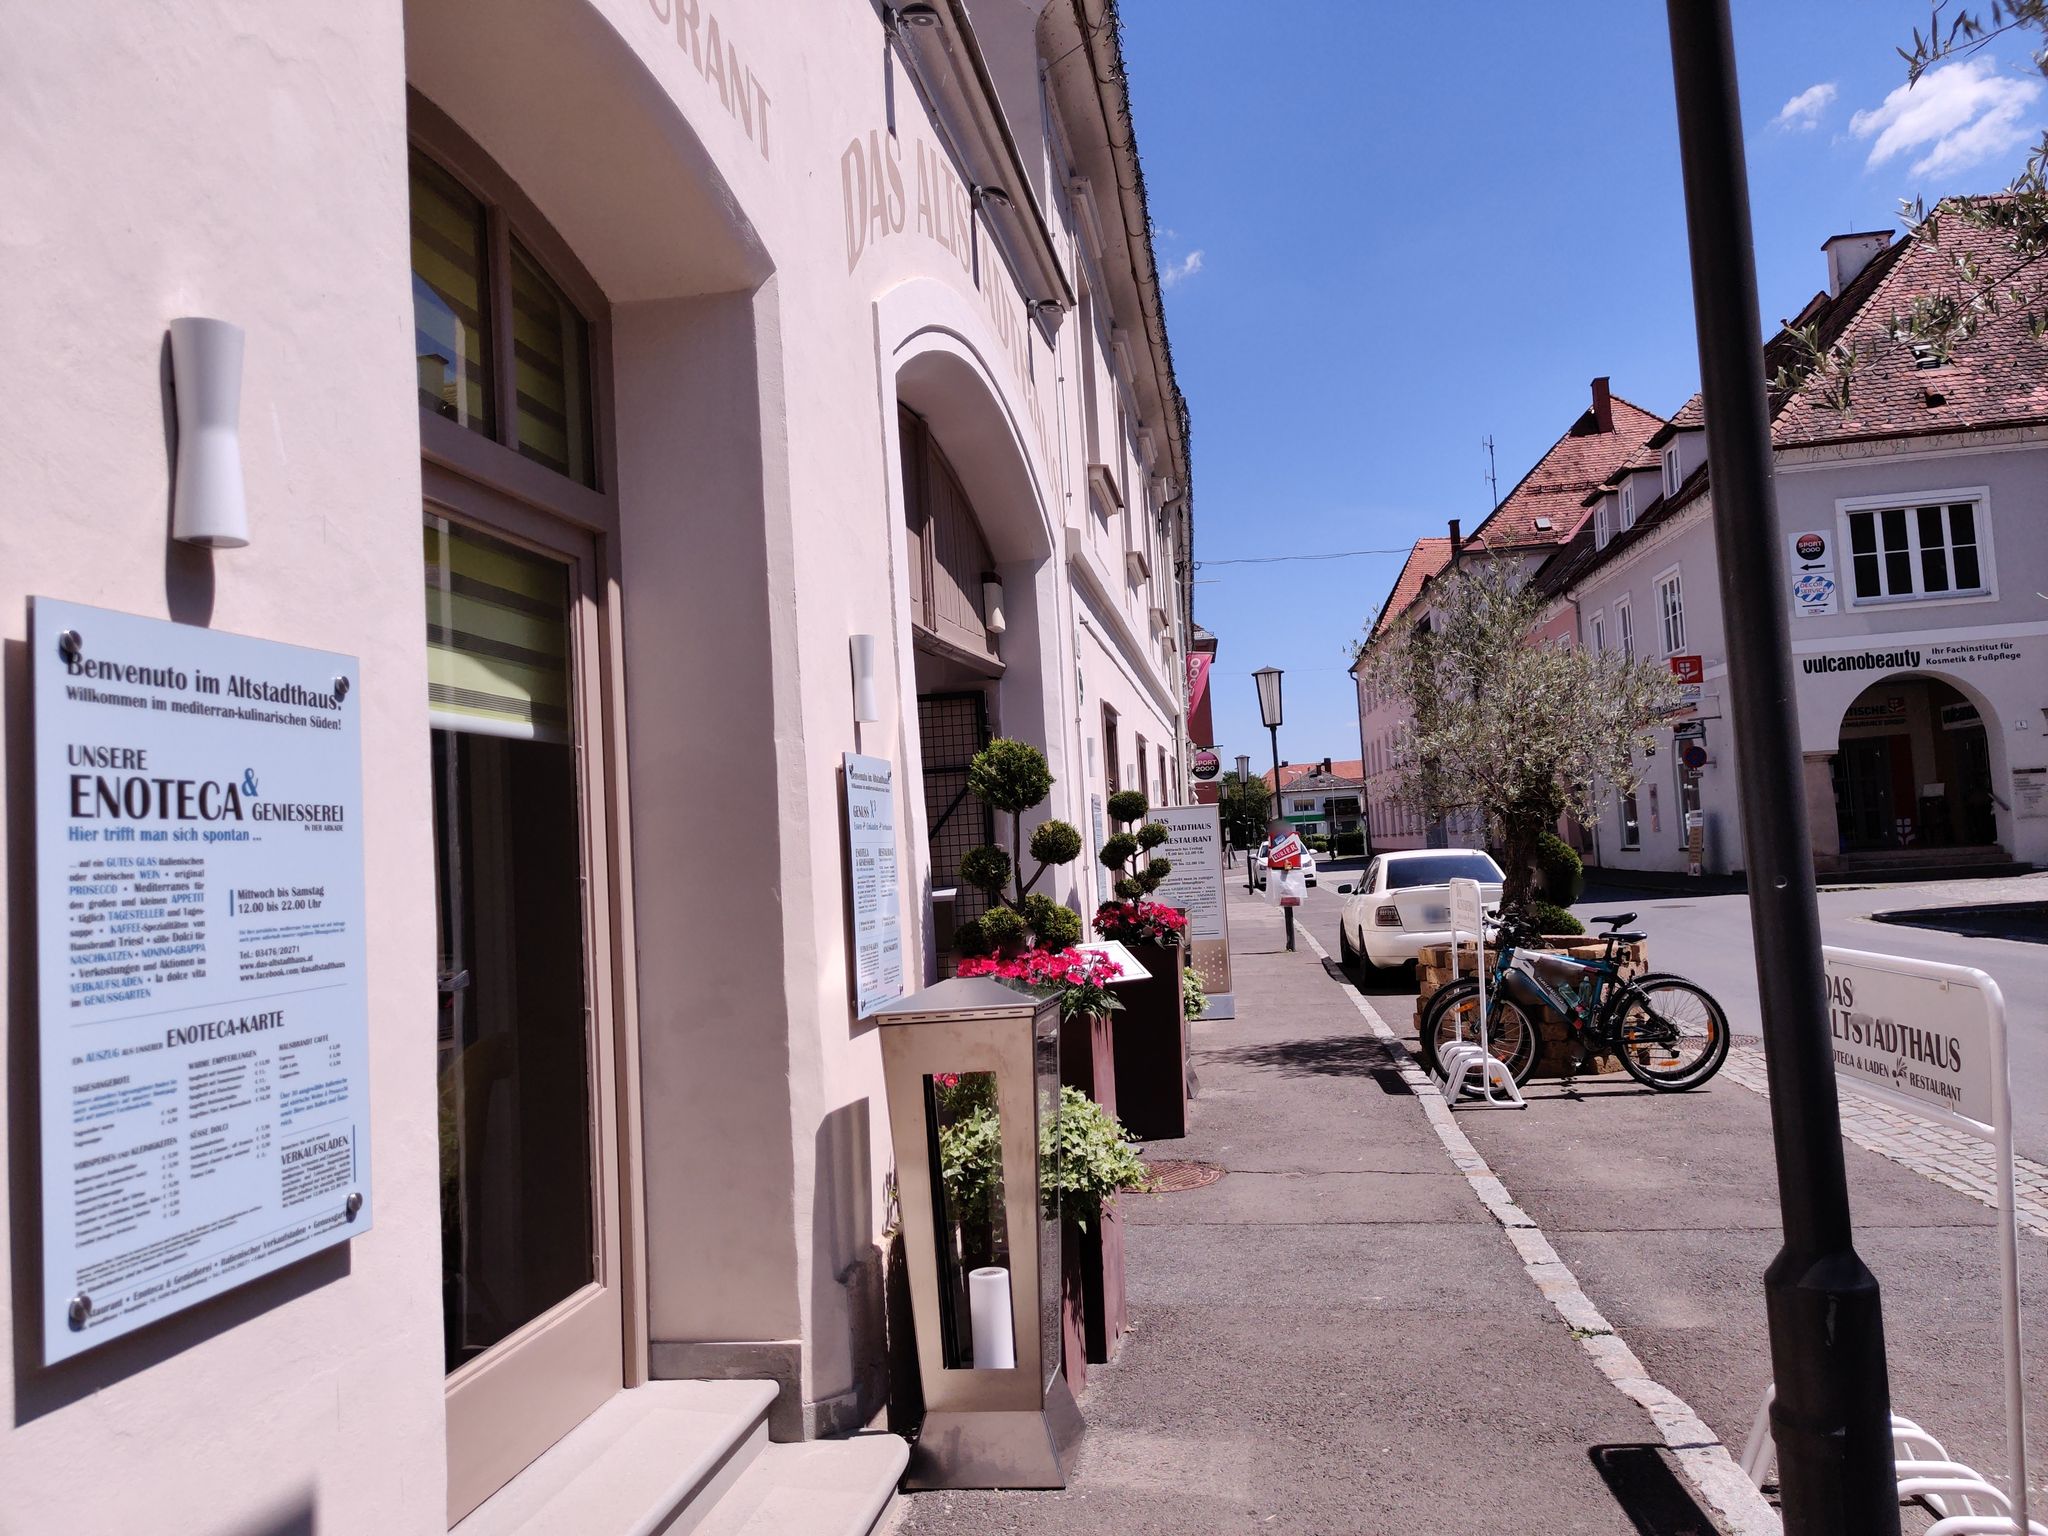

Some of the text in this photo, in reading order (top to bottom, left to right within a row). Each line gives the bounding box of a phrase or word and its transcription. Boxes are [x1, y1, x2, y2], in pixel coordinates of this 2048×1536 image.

[841, 128, 905, 276] DAS
[1798, 540, 1823, 549] SPORT
[1931, 641, 2014, 655] Ihr Fachinstitut für
[1802, 649, 1921, 674] vulcanobeauty
[1926, 652, 2022, 665] Kosmetik & Fußpflege
[67, 651, 188, 690] Benvenuto
[195, 669, 220, 694] im
[66, 686, 342, 730] Willkommen im mediterran-kulinarischen Süden!
[67, 744, 149, 771] UNSERE
[1195, 759, 1217, 767] SPORT
[70, 767, 259, 821] ENOTECA &
[252, 802, 344, 822] GENIESSEREI
[68, 826, 98, 842] Hier
[103, 826, 137, 842] trifft
[140, 829, 169, 842] man
[172, 826, 199, 842] sich
[203, 829, 250, 844] spontan
[106, 857, 134, 867] GUTES
[136, 857, 158, 867] GLAS
[140, 870, 161, 879] WEIN
[174, 869, 205, 879] original
[69, 884, 118, 896] PROSECCO
[134, 882, 190, 893] Mediterranes
[238, 885, 325, 900] Mittwoch bis Samstag
[121, 897, 136, 906] und
[171, 893, 205, 903] APPETIT
[238, 898, 323, 914] 12.00 bis 22.00 Uhr
[108, 908, 166, 921] TAGESTELLER
[118, 936, 145, 947] Triest
[172, 931, 194, 942] Dolci
[70, 950, 134, 965] NASCHKATZEN
[79, 964, 141, 978] Verkostungen
[160, 958, 195, 969] Aktionen
[70, 976, 144, 993] VERKAUFSLADEN
[84, 988, 152, 1007] GENUSSGARTEN
[86, 1047, 120, 1062] AUSZUG
[167, 1009, 285, 1049] ENOTECA-KARTE
[1831, 1008, 1962, 1073] LTSTADTHAUS
[1857, 1057, 1890, 1078] & LADEN
[1909, 1072, 1962, 1103] RESTAURANT
[281, 1135, 350, 1166] VERKAUFSLADEN
